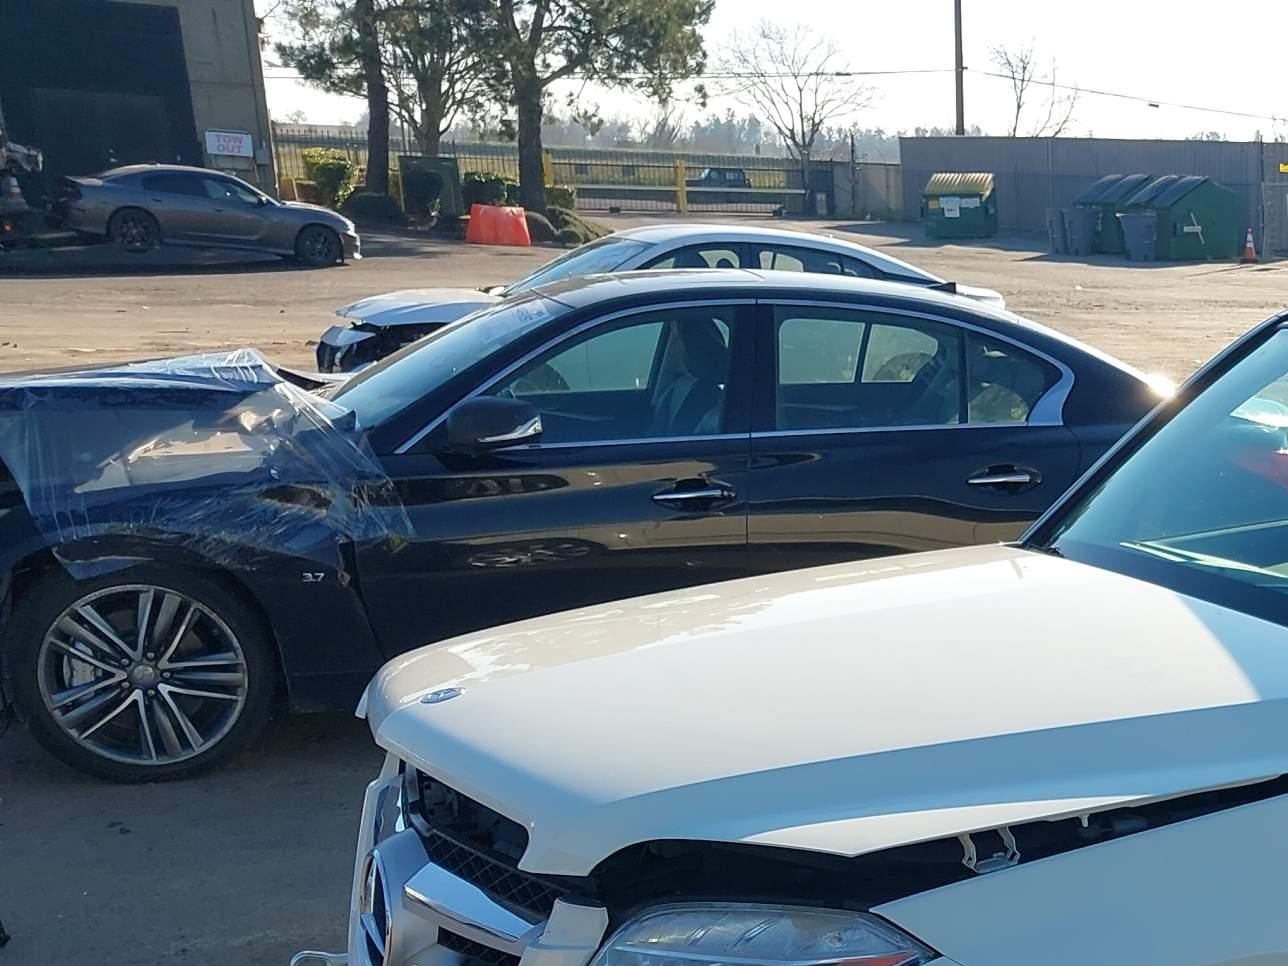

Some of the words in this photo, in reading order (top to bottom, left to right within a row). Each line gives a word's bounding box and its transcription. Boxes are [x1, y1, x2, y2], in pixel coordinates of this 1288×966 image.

[216, 134, 243, 144] TOW
[216, 144, 243, 154] OUT
[302, 572, 325, 583] 3.7
